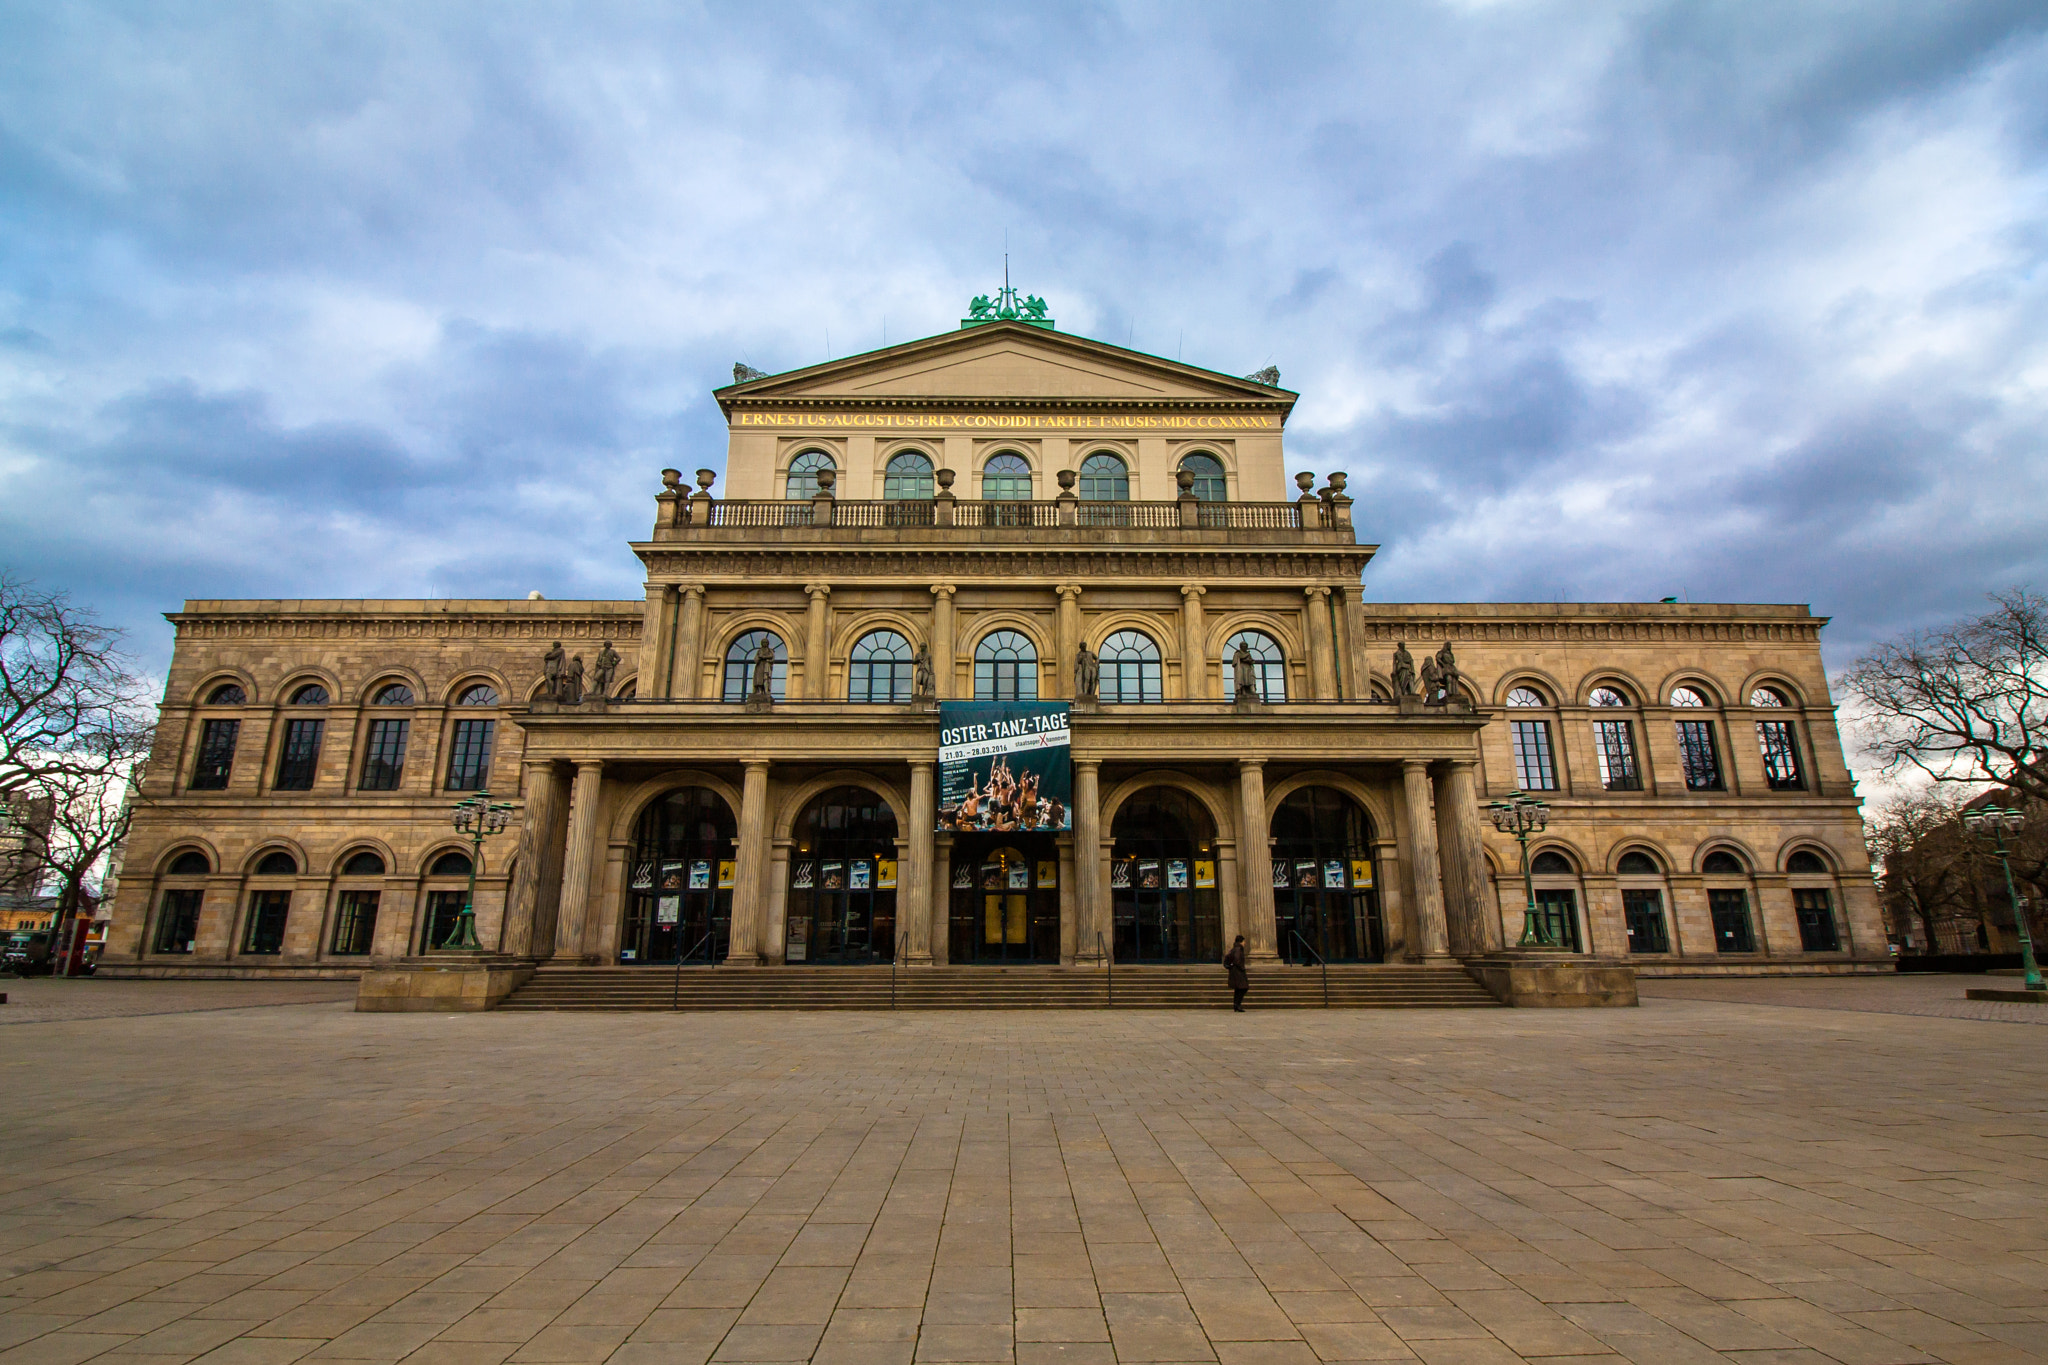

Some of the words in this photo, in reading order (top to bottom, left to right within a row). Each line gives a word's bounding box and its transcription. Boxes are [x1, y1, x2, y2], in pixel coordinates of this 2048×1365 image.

[741, 413, 827, 425] ERNESTUS
[831, 414, 915, 426] AUGUSTUS
[928, 415, 961, 426] REX
[964, 415, 1043, 427] CONDIDIT
[1045, 416, 1082, 427] ARTI
[1086, 416, 1108, 427] ET
[1111, 416, 1157, 427] MUSIS
[1162, 416, 1271, 427] MDCCCXXXXV
[942, 713, 1068, 745] OSTER-TANZ-TAGE
[945, 751, 965, 759] 21.03.
[972, 745, 1007, 756] 28.03.2016
